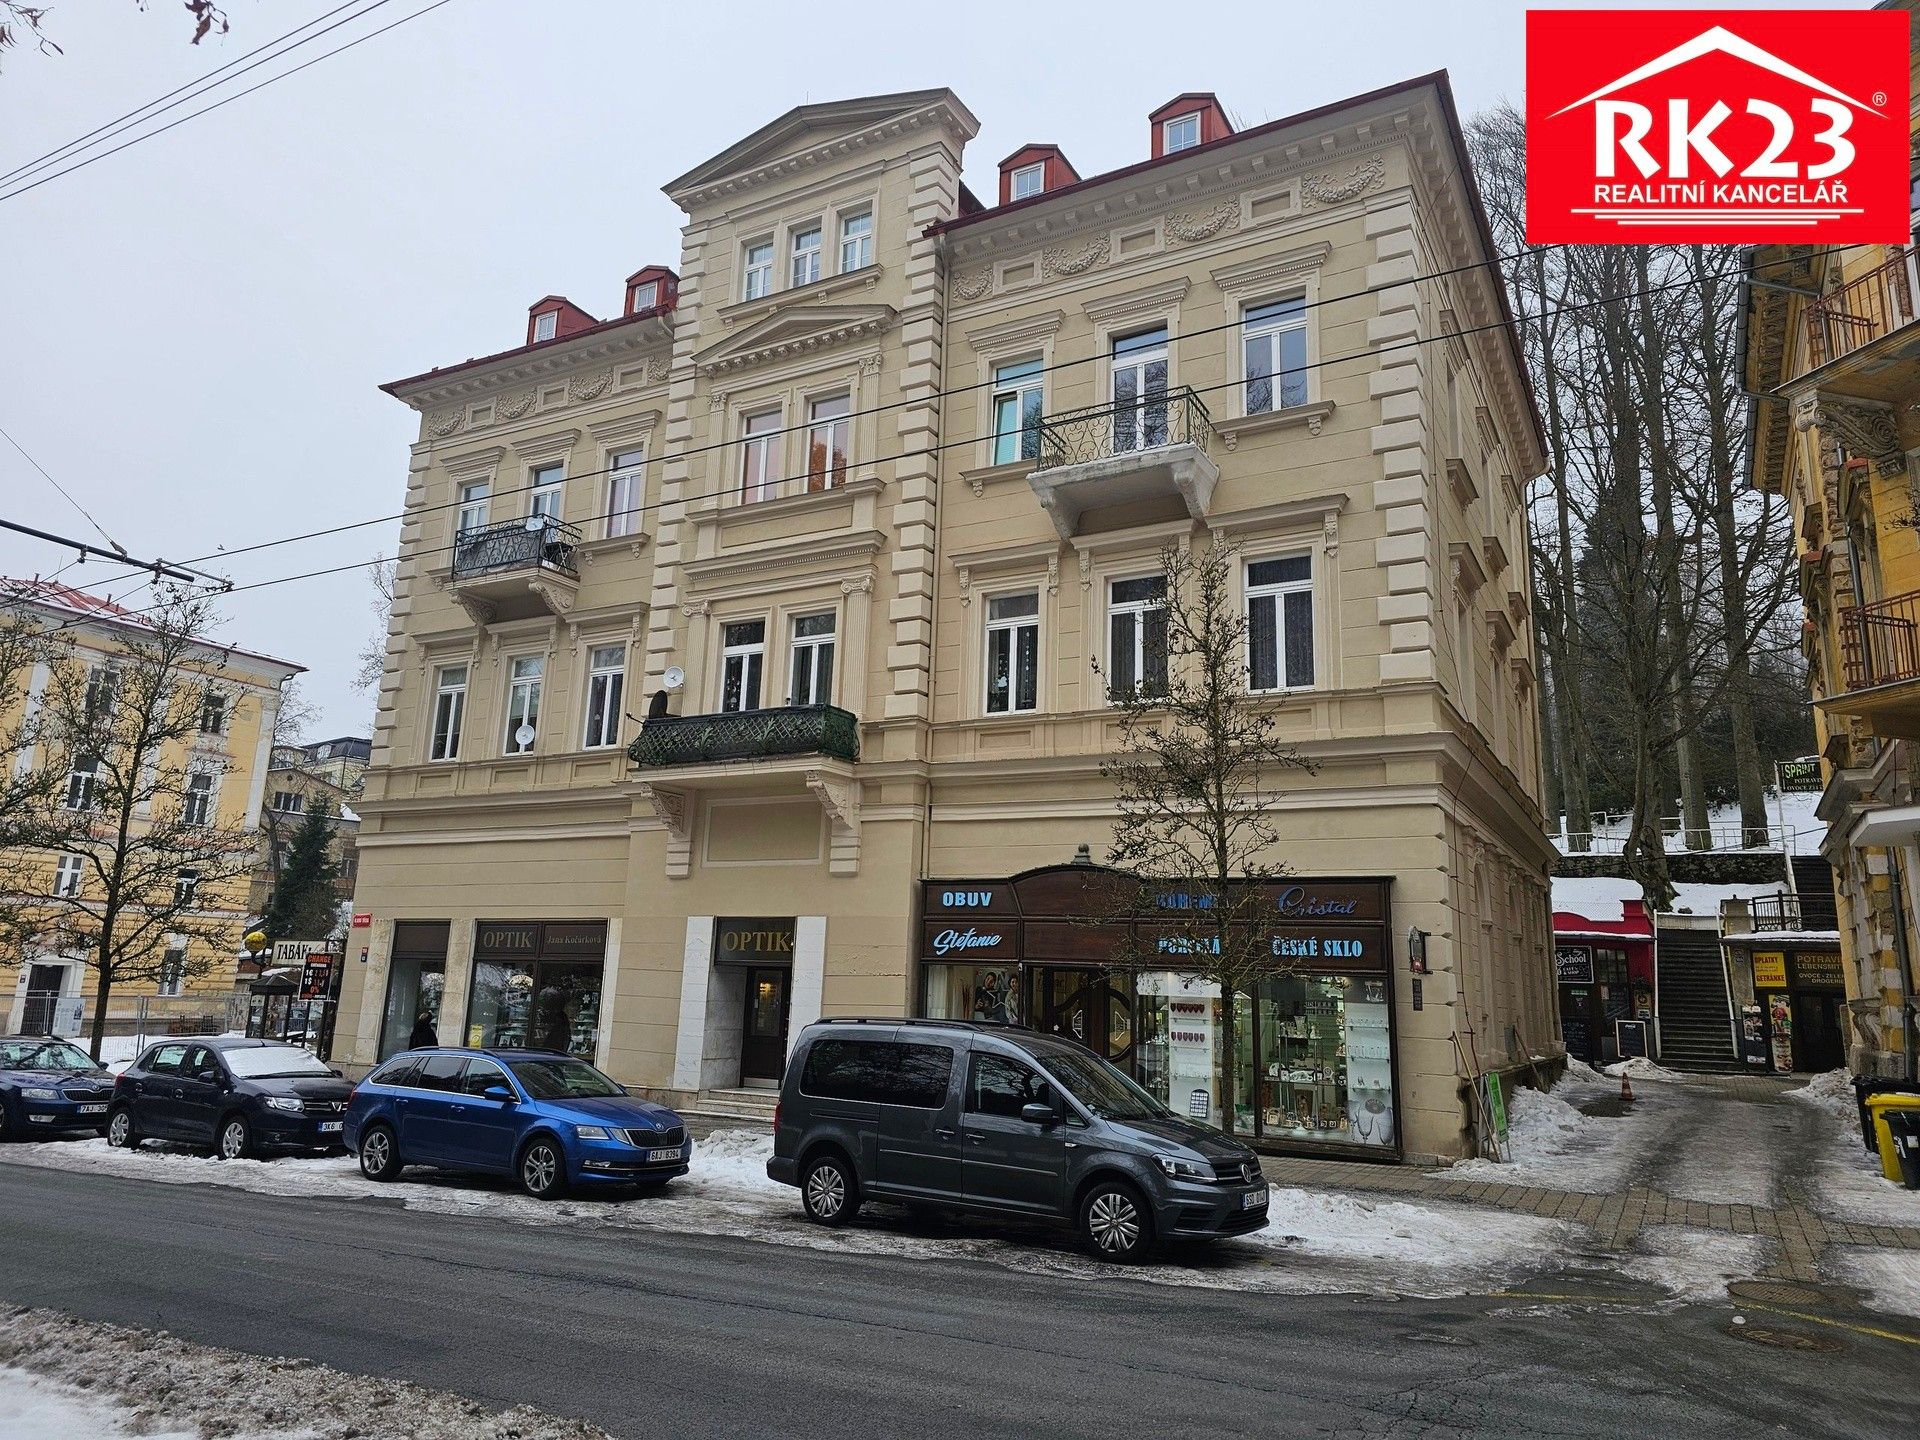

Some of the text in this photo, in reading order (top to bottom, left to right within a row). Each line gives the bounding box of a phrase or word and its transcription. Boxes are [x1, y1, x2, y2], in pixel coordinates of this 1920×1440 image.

[1784, 763, 1815, 779] SPRINT
[942, 892, 992, 907] OBUV
[483, 931, 533, 948] OPTIK
[723, 931, 791, 952] OPTIK
[933, 928, 1002, 955] Stefanie
[1272, 935, 1363, 957] ČESKÉ SKLO
[308, 955, 331, 963] CHANGE
[1555, 952, 1587, 966] School
